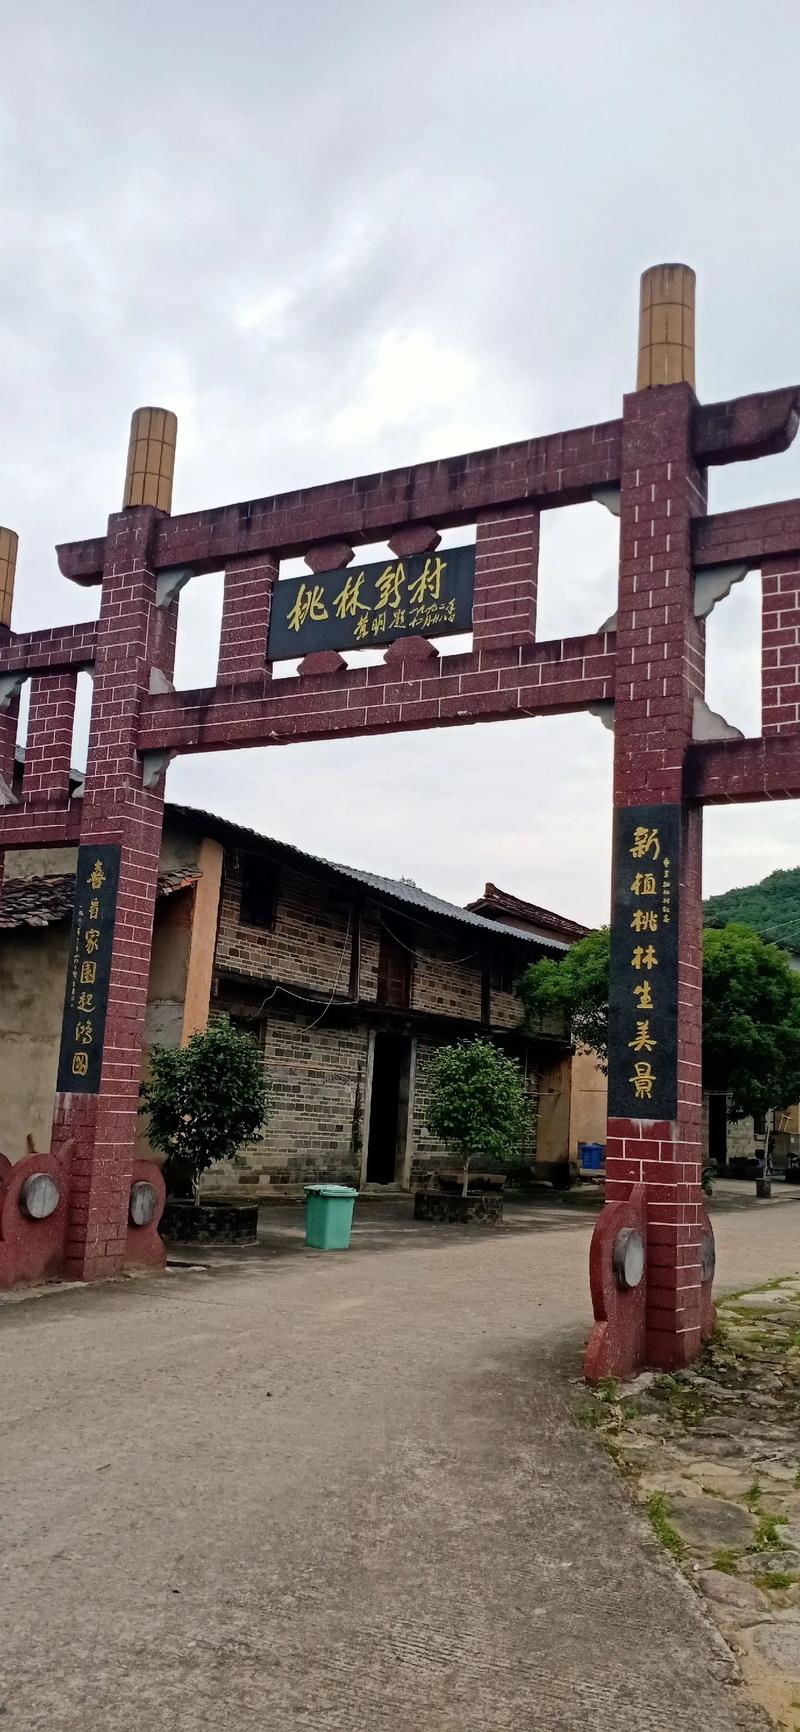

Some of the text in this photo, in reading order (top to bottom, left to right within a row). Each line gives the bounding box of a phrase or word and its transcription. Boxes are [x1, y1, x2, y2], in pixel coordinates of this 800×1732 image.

[628, 826, 661, 1099] 新植桃林生美景
